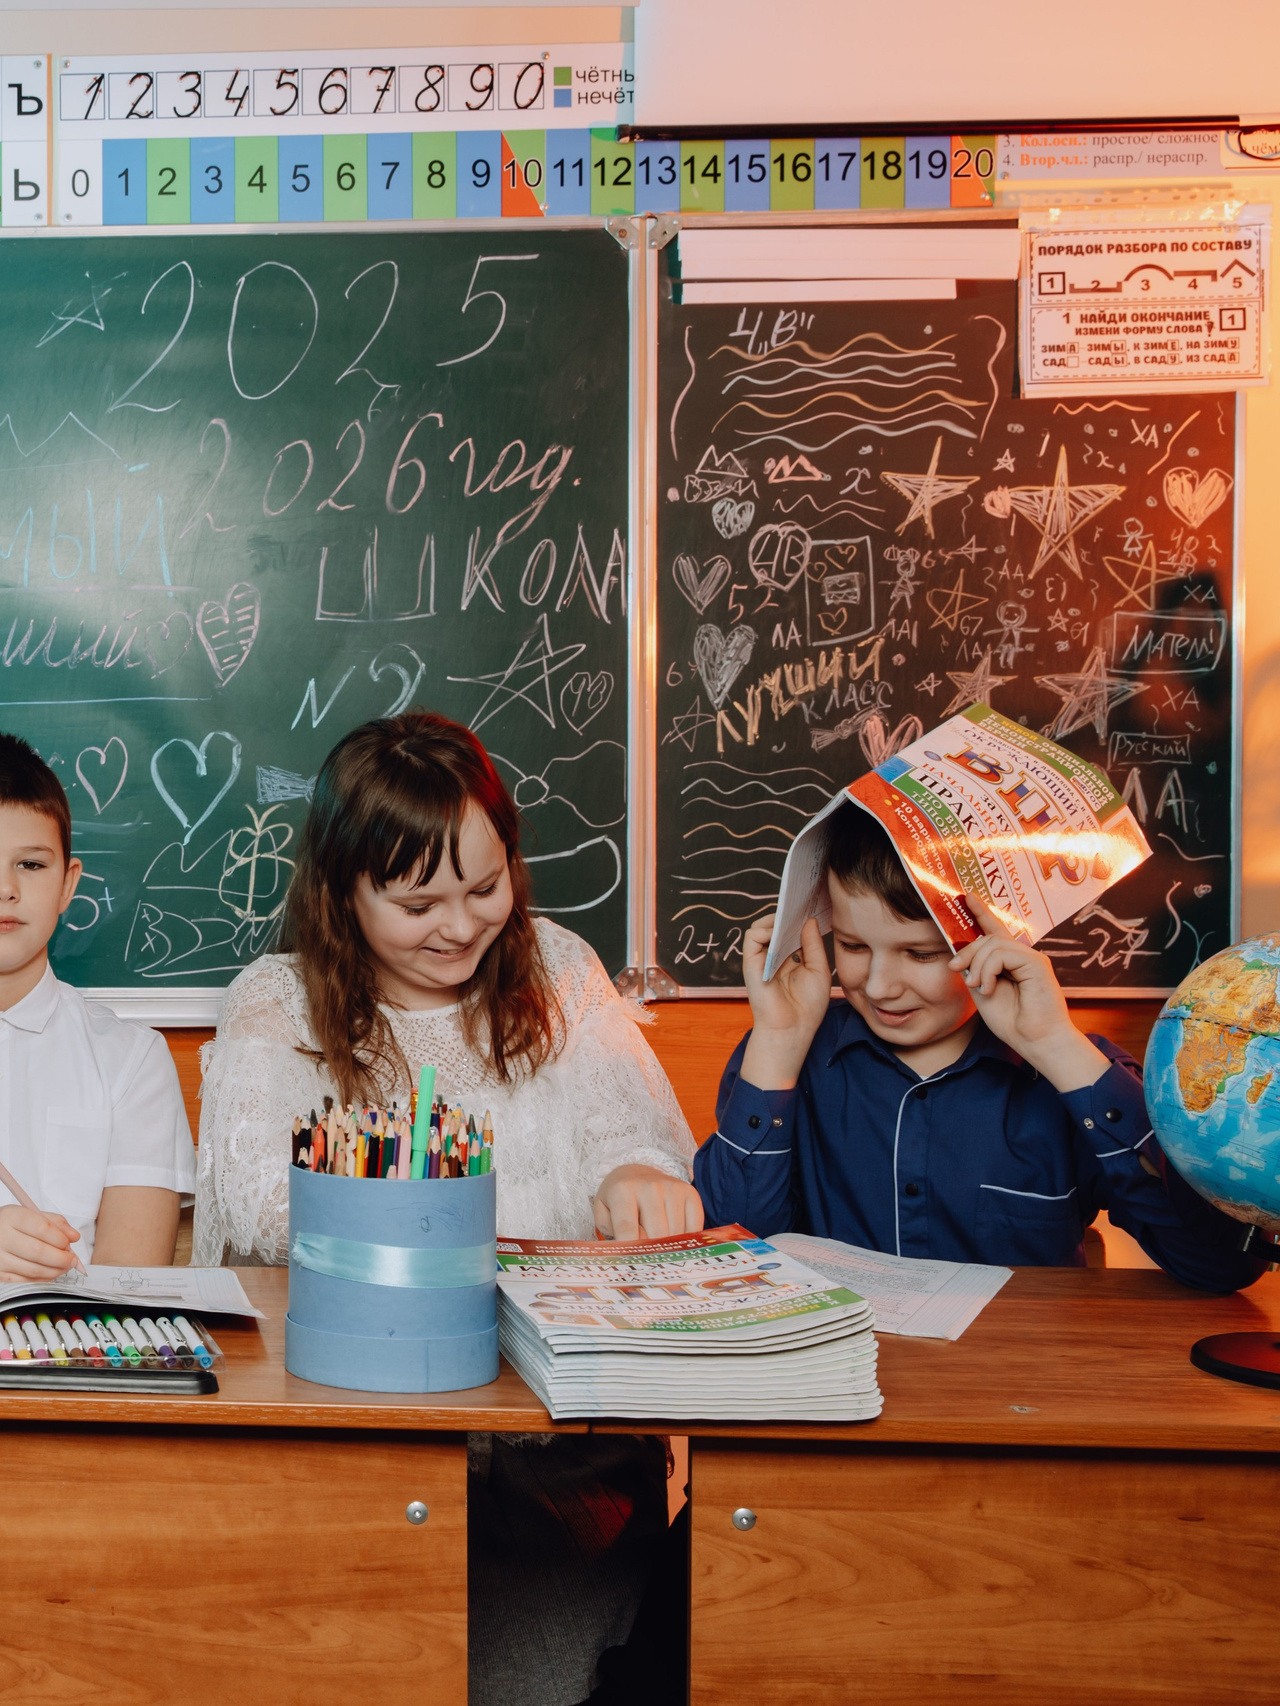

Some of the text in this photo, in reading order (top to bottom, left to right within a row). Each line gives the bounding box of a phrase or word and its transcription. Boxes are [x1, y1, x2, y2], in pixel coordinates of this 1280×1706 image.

[1157, 133, 1218, 144] сложное
[1003, 155, 1015, 166] 4.
[1147, 151, 1208, 165] нераспр.
[71, 148, 994, 197] 0 1 2 3 4 5 6 7 8 9 10 11 12 13 14 15 16 17 18 19 20
[1038, 239, 1253, 256] ПОРЯДОК РАЗБОРА ПО СОСТАВУ
[1140, 280, 1150, 291] 3
[1187, 279, 1198, 290] 4
[1232, 277, 1242, 289] 5
[1080, 310, 1127, 325] НАЙДИ
[1130, 311, 1210, 323] ОКОНЧАНИЕ
[107, 253, 540, 414] 2025
[1075, 325, 1203, 336] ИЗМЕНИ ФОРМУ СЛОВА
[1186, 341, 1200, 349] НА
[1042, 358, 1067, 367] САД
[1186, 354, 1200, 363] ИЗ
[179, 412, 444, 539] 2026
[922, 763, 999, 836] НАЧАЛЬНО
